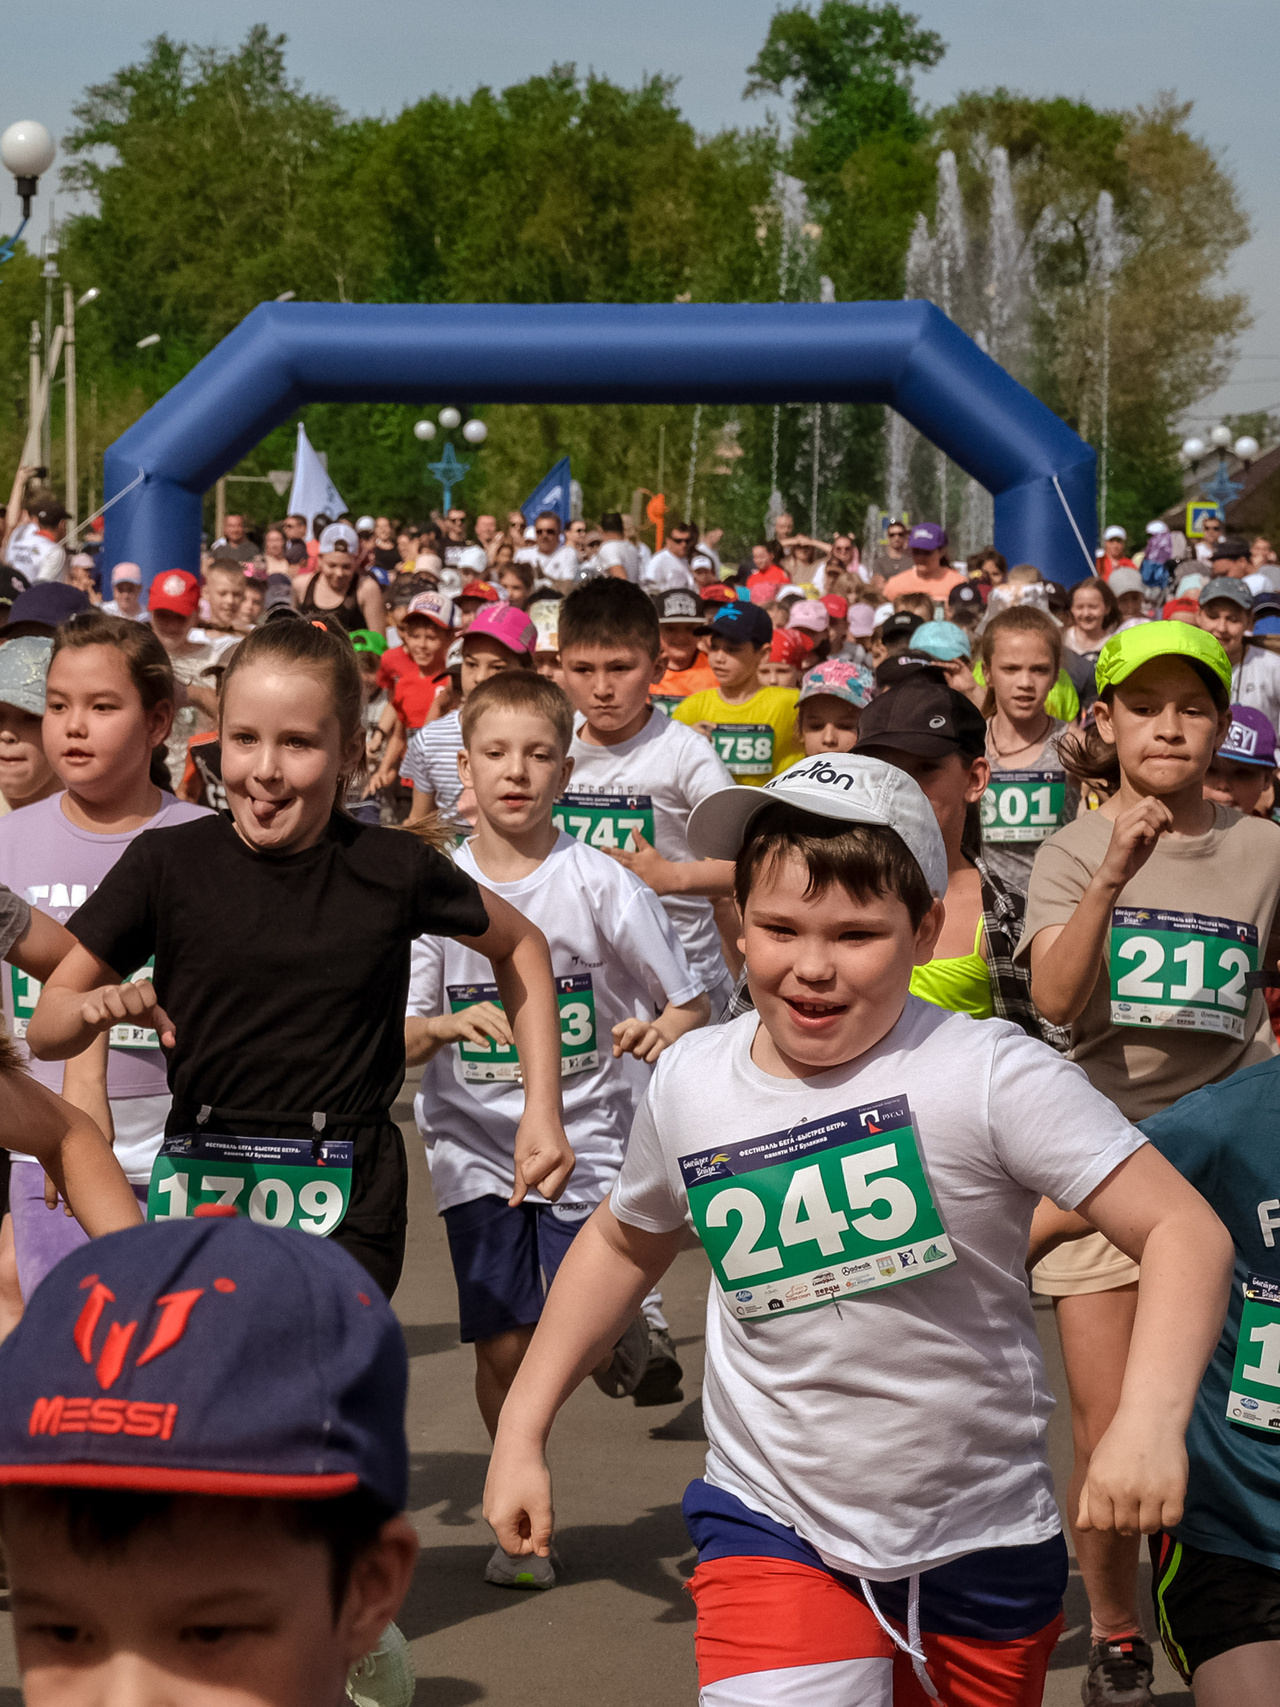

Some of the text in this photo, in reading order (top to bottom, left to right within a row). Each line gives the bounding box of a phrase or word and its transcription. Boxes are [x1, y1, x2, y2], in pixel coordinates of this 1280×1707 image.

[711, 736, 772, 761] 758
[1228, 725, 1254, 750] EY
[1117, 935, 1251, 1013] 212
[739, 1143, 779, 1158] ФЕСТИВАЛЬ
[779, 1138, 795, 1150] БЕГА
[154, 1172, 344, 1236] 1709
[706, 1142, 918, 1281] 245
[28, 1394, 179, 1441] MESSI
